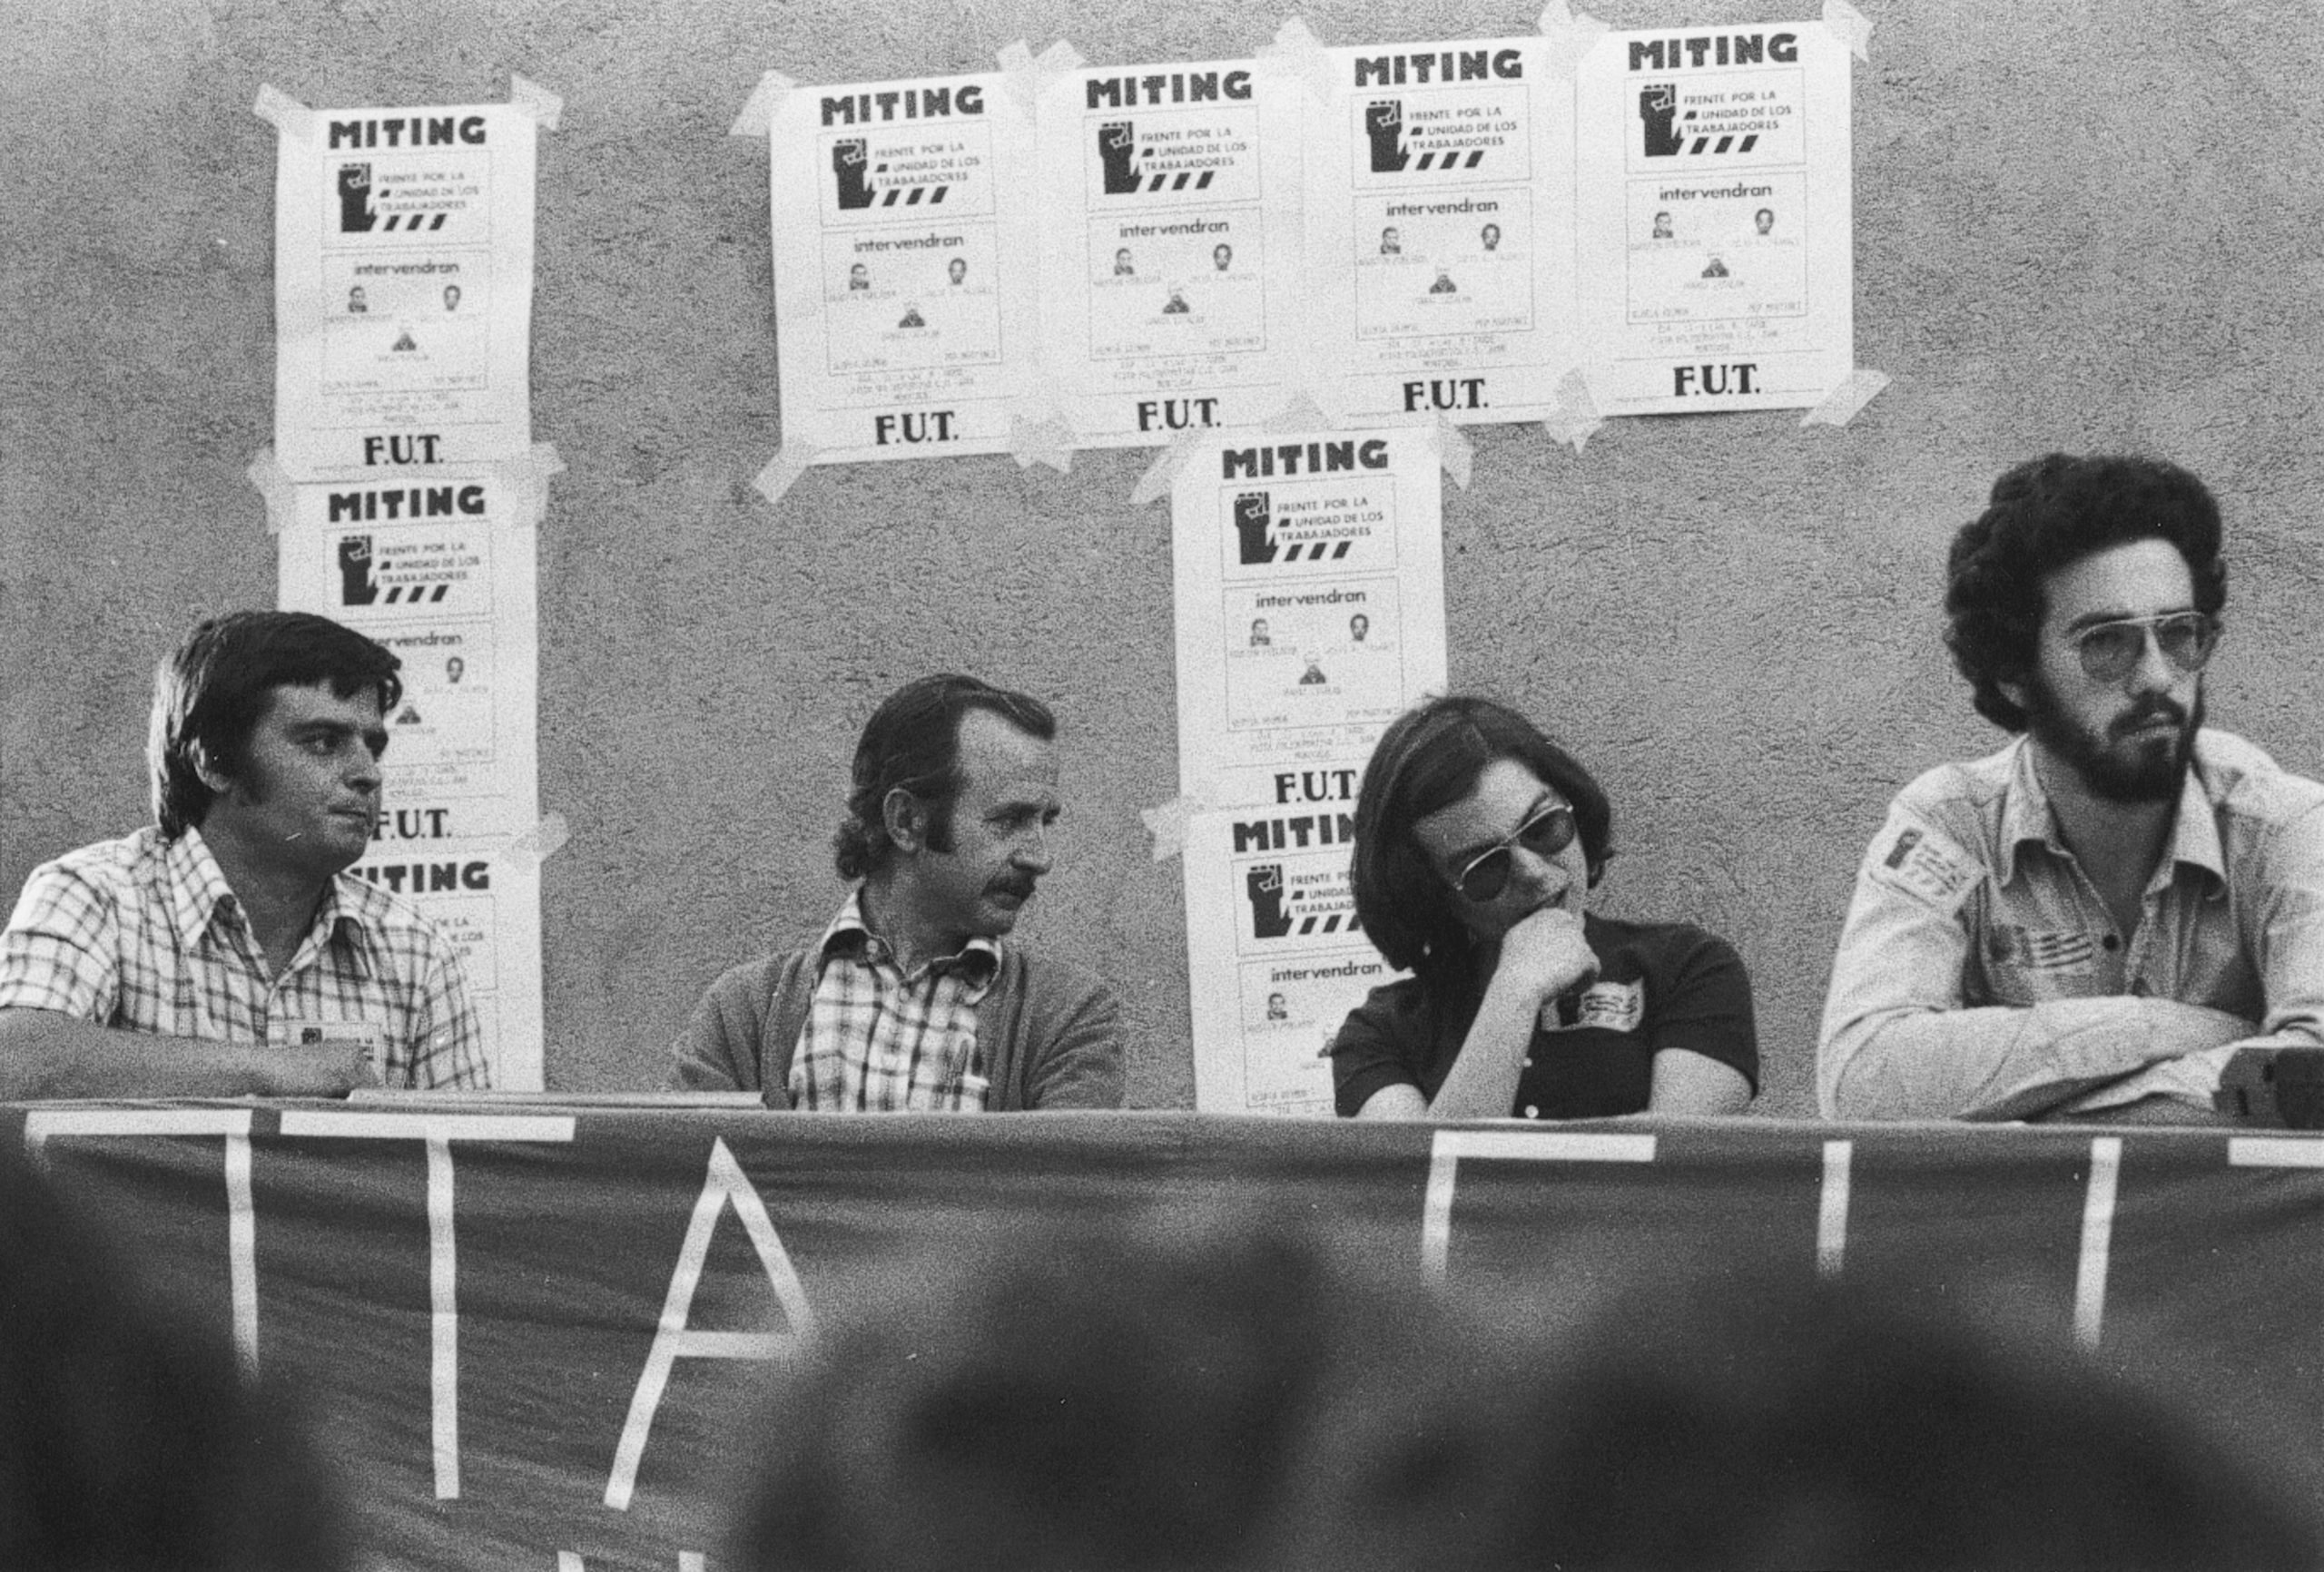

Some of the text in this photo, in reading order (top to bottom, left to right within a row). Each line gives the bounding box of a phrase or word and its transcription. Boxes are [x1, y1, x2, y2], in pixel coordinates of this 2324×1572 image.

[1629, 34, 1797, 71] MITING
[1354, 50, 1522, 87] MITING
[1087, 71, 1251, 109] MITING
[1684, 92, 1776, 105] FRENTE POR LA
[822, 85, 983, 126] MITING
[1410, 107, 1502, 122] FRENTE POR LA
[1702, 106, 1791, 120] UNIDAD DE LOS
[329, 116, 486, 149] MITING
[1141, 128, 1231, 142] FRENTE POR LA
[1428, 122, 1516, 135] UNIDAD DE LOS
[1687, 121, 1778, 133] TRABAJADORES
[875, 142, 964, 158] FRENTE POR LA
[1158, 142, 1246, 156] UNIDAD DE LOS
[1413, 137, 1504, 149] TRABAJADORES
[893, 157, 980, 172] UNIDAD DE LOS
[1145, 157, 1234, 171] TRABAJADORES
[878, 172, 968, 187] TRABAJADORES
[1659, 183, 1772, 201] intervendran
[1386, 199, 1498, 217] intervendran
[1120, 220, 1229, 238] intervendran
[854, 234, 964, 253] intervendran
[1673, 364, 1760, 397] F.U.T.
[1403, 378, 1489, 411] F.U.T.
[1137, 398, 1221, 431] F.U.T.
[876, 411, 958, 445] F.U.T.
[364, 435, 444, 465] F.U.T.
[1223, 439, 1388, 479] MITING
[329, 486, 485, 523] MITING
[1277, 497, 1367, 513] FRENTE POR LA
[1295, 511, 1383, 526] UNIDAD DE LOS
[1281, 527, 1371, 541] TRABAJADORES
[1256, 589, 1365, 608] intervendran
[1233, 813, 1354, 852] MITIN
[350, 861, 489, 894] ITING
[1290, 873, 1330, 886] FRENTE
[1295, 900, 1354, 915] TRABAJAD
